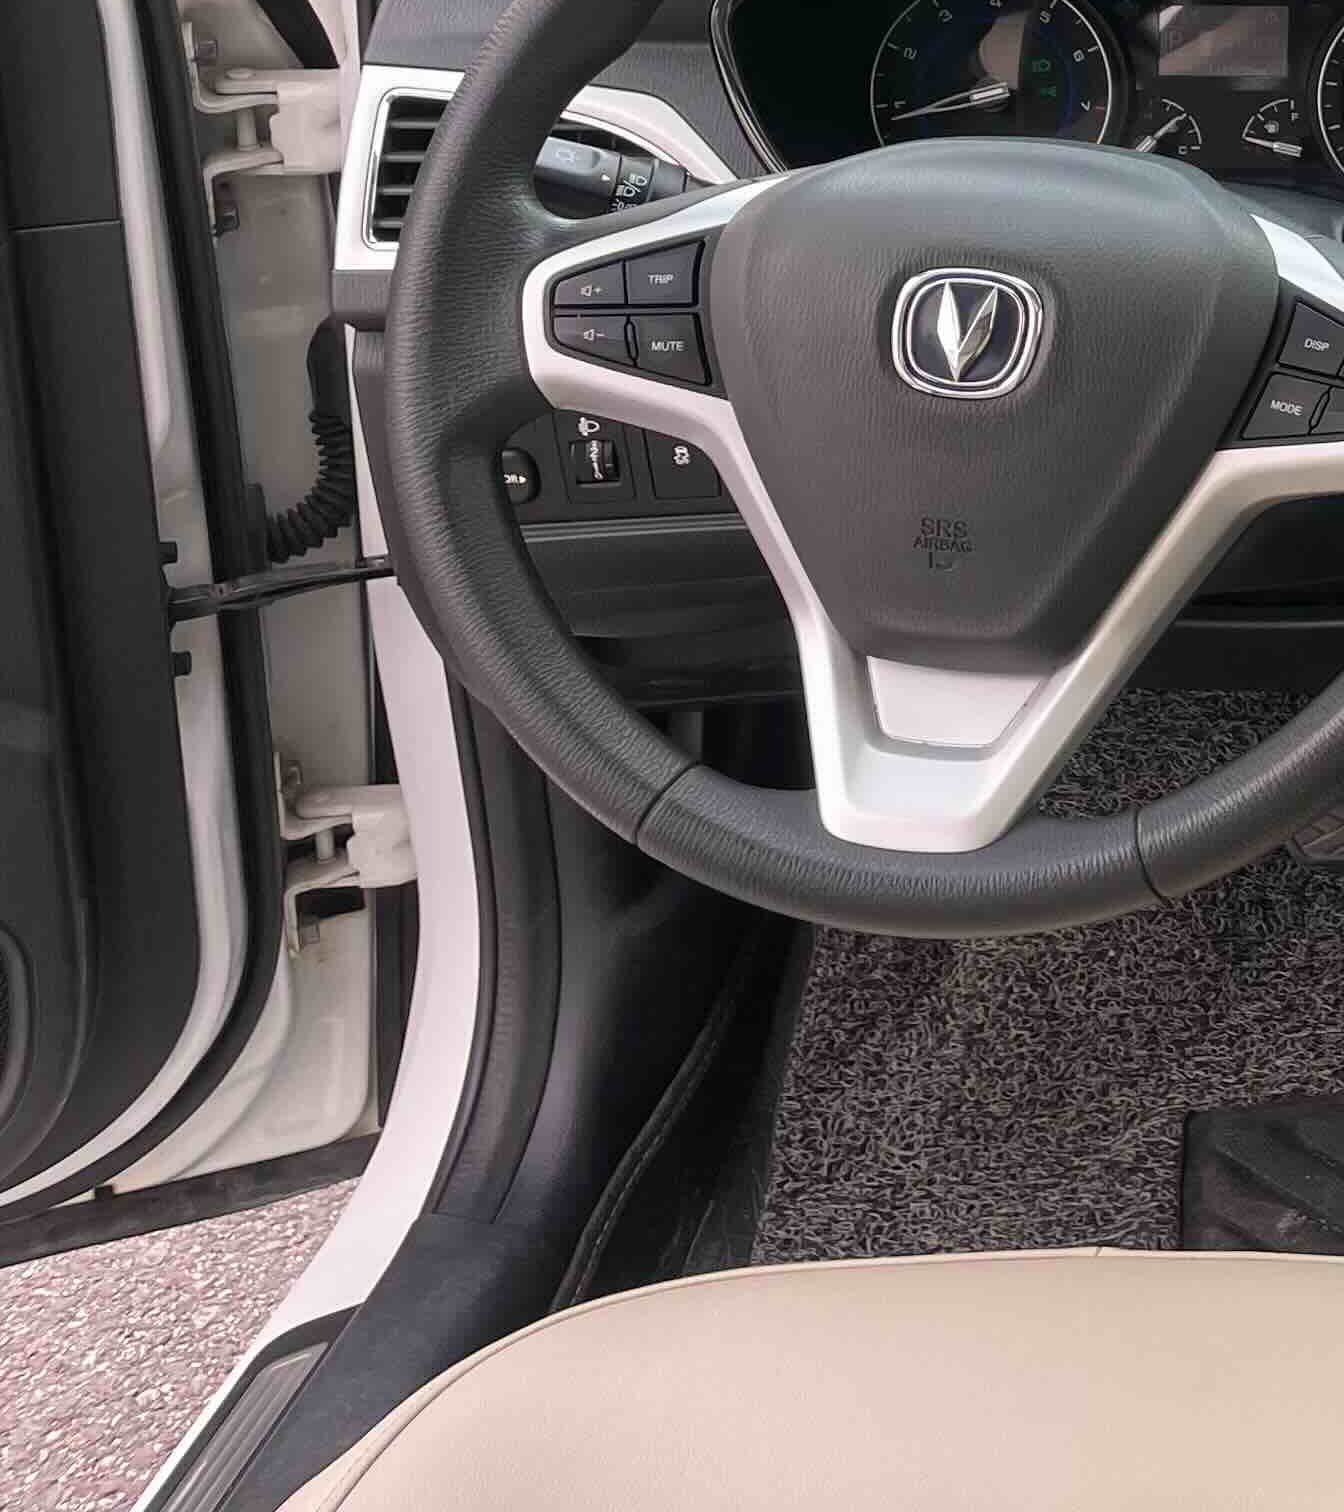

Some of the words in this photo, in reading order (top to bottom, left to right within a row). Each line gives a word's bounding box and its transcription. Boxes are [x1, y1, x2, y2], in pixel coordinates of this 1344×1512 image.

[648, 273, 674, 286] TRIP
[651, 341, 685, 352] MUTE
[1303, 337, 1330, 352] DISP
[1270, 399, 1304, 417] MODE
